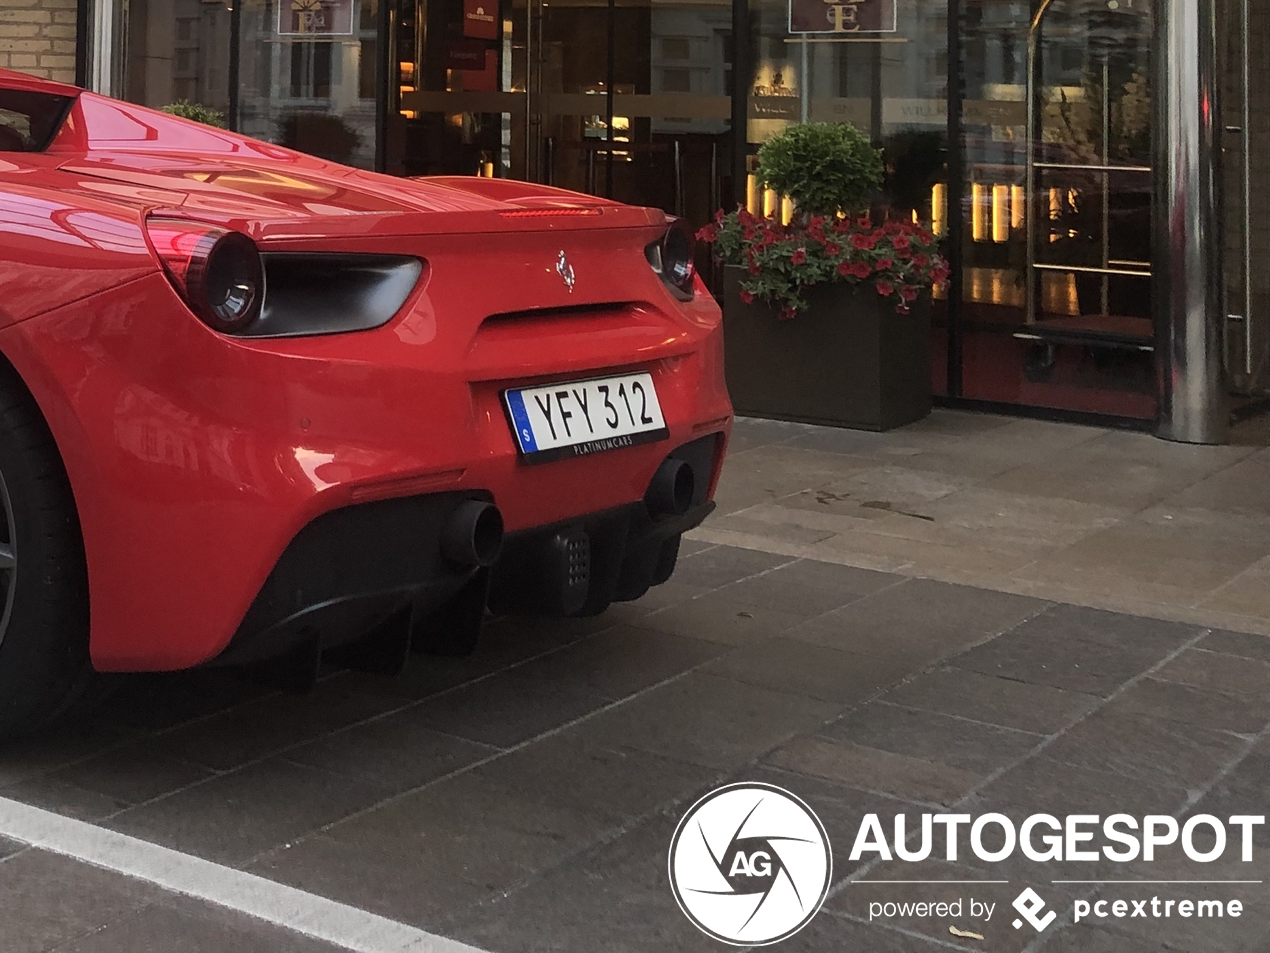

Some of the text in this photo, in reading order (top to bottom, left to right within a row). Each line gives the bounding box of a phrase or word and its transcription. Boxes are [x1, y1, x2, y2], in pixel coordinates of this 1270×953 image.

[534, 381, 653, 440] YFY 312
[522, 428, 531, 442] S
[573, 436, 633, 455] PLATINUMCARS
